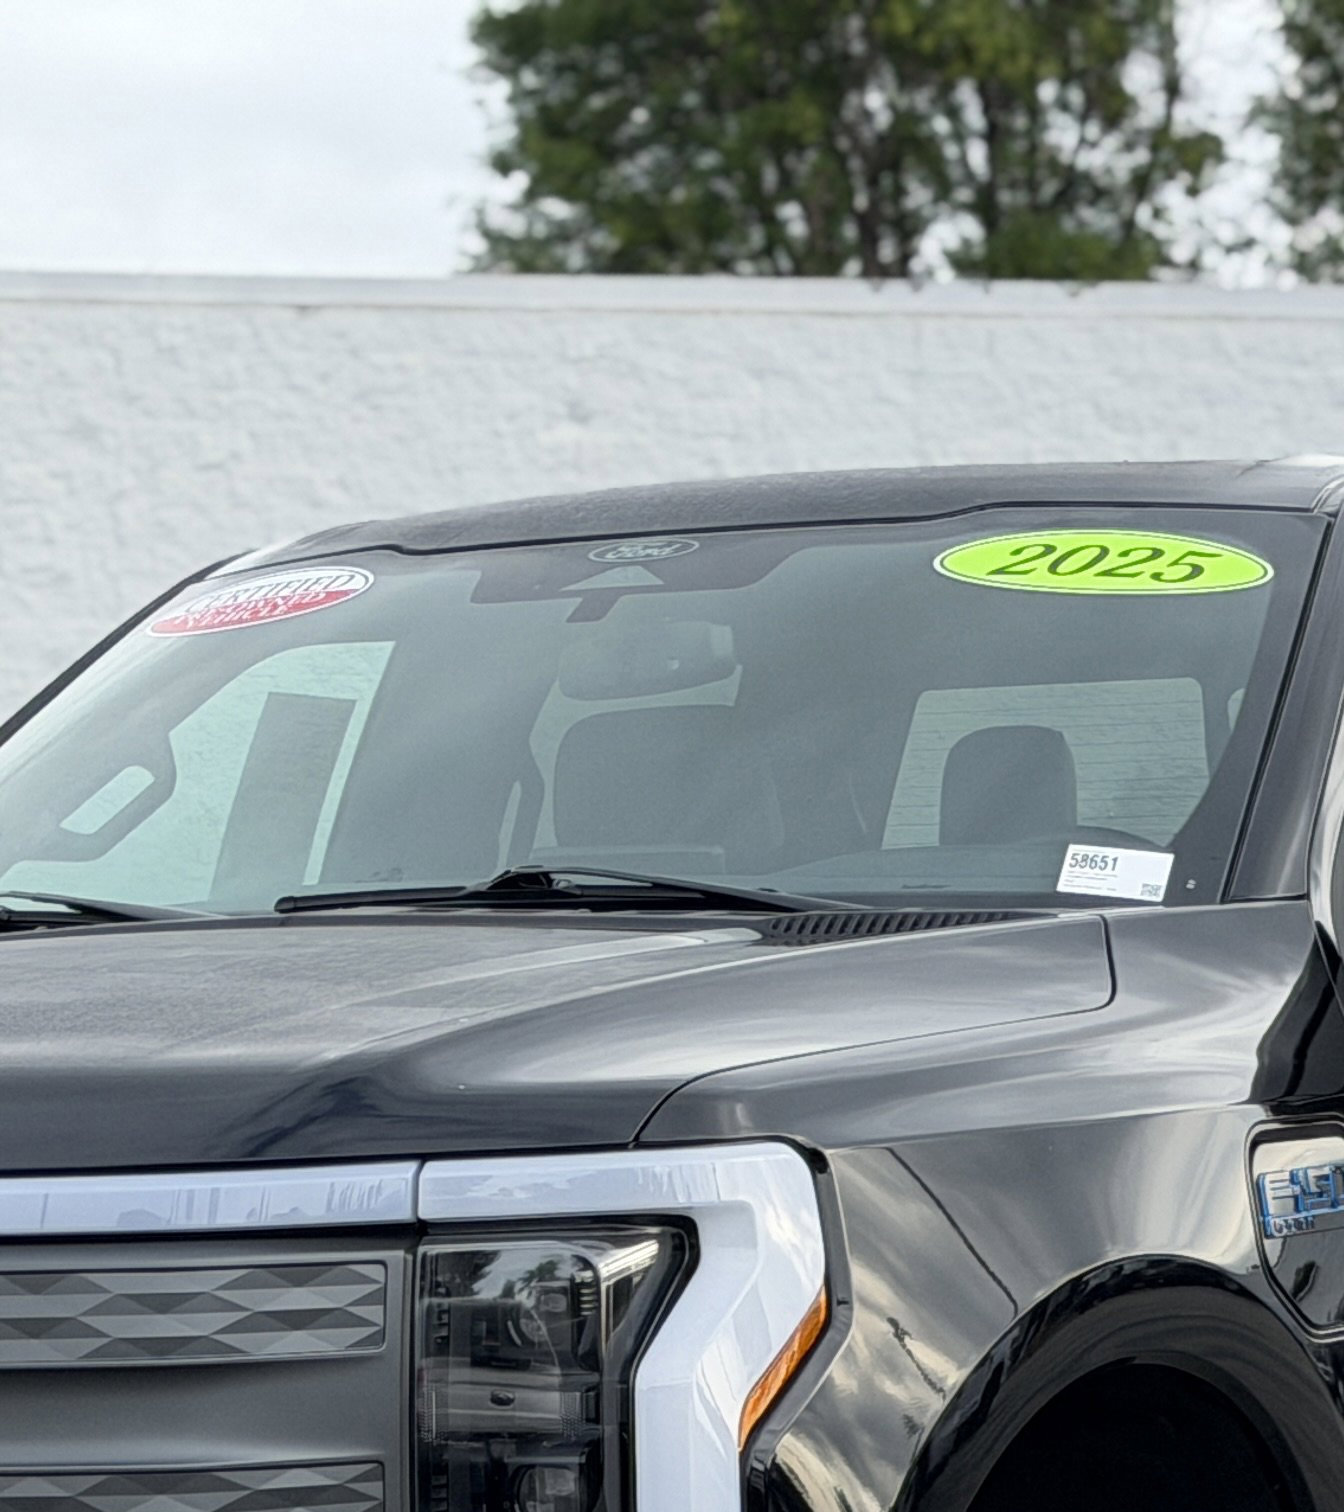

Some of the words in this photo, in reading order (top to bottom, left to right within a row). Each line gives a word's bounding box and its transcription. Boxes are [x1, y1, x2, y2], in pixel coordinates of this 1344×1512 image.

[986, 543, 1221, 585] 2025
[185, 573, 356, 614] CERTIFIED
[1068, 853, 1119, 871] 58651
